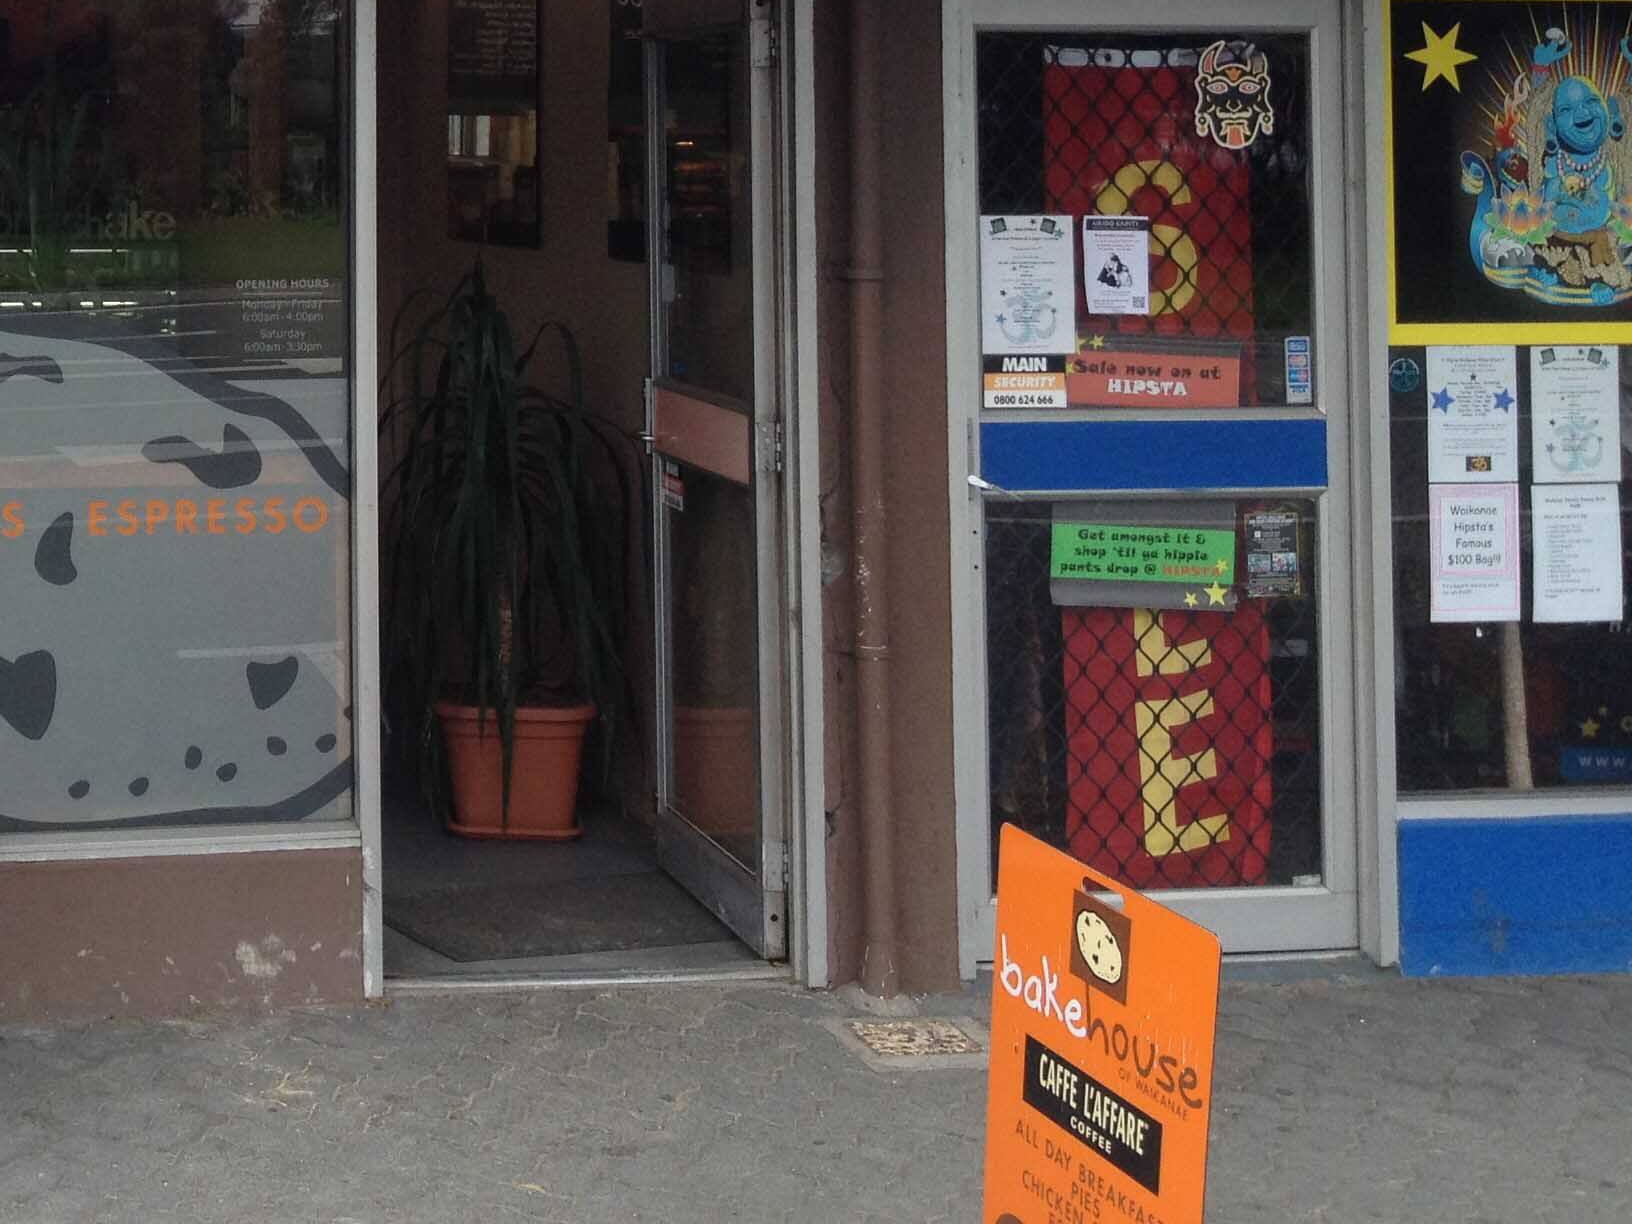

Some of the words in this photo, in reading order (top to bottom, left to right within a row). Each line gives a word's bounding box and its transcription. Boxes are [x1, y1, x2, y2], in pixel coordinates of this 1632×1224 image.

[235, 279, 288, 289] OPENING
[290, 278, 329, 289] HOURS
[259, 327, 306, 340] Saturday
[1001, 357, 1048, 372] MAIN
[1074, 359, 1117, 376] Sale
[1126, 364, 1161, 377] now
[1170, 366, 1192, 378] on
[1199, 366, 1221, 380] at
[993, 375, 1057, 389] SECURITY
[1106, 378, 1188, 396] HIPSTA
[994, 394, 1017, 406] 0800
[1018, 394, 1036, 406] 624
[1036, 395, 1054, 406] 666
[88, 496, 329, 539] ESPRESSO
[1453, 521, 1494, 535] Hipsta's
[1077, 529, 1106, 541] Get
[1111, 532, 1171, 546] amongst
[1455, 537, 1493, 549] Famous
[1074, 545, 1107, 559] shop
[1164, 549, 1209, 564] hippie
[1448, 553, 1473, 567] $100
[1059, 562, 1102, 575] pants
[1107, 562, 1139, 577] drop
[1143, 563, 1157, 576] @
[1039, 1053, 1078, 1110] CAFFE
[1135, 1075, 1188, 1121] WAIKANAE
[1070, 1115, 1112, 1155] COFFEE
[1016, 1119, 1039, 1149] ALL
[1045, 1137, 1072, 1172] DAY
[1071, 1181, 1101, 1218] PIES
